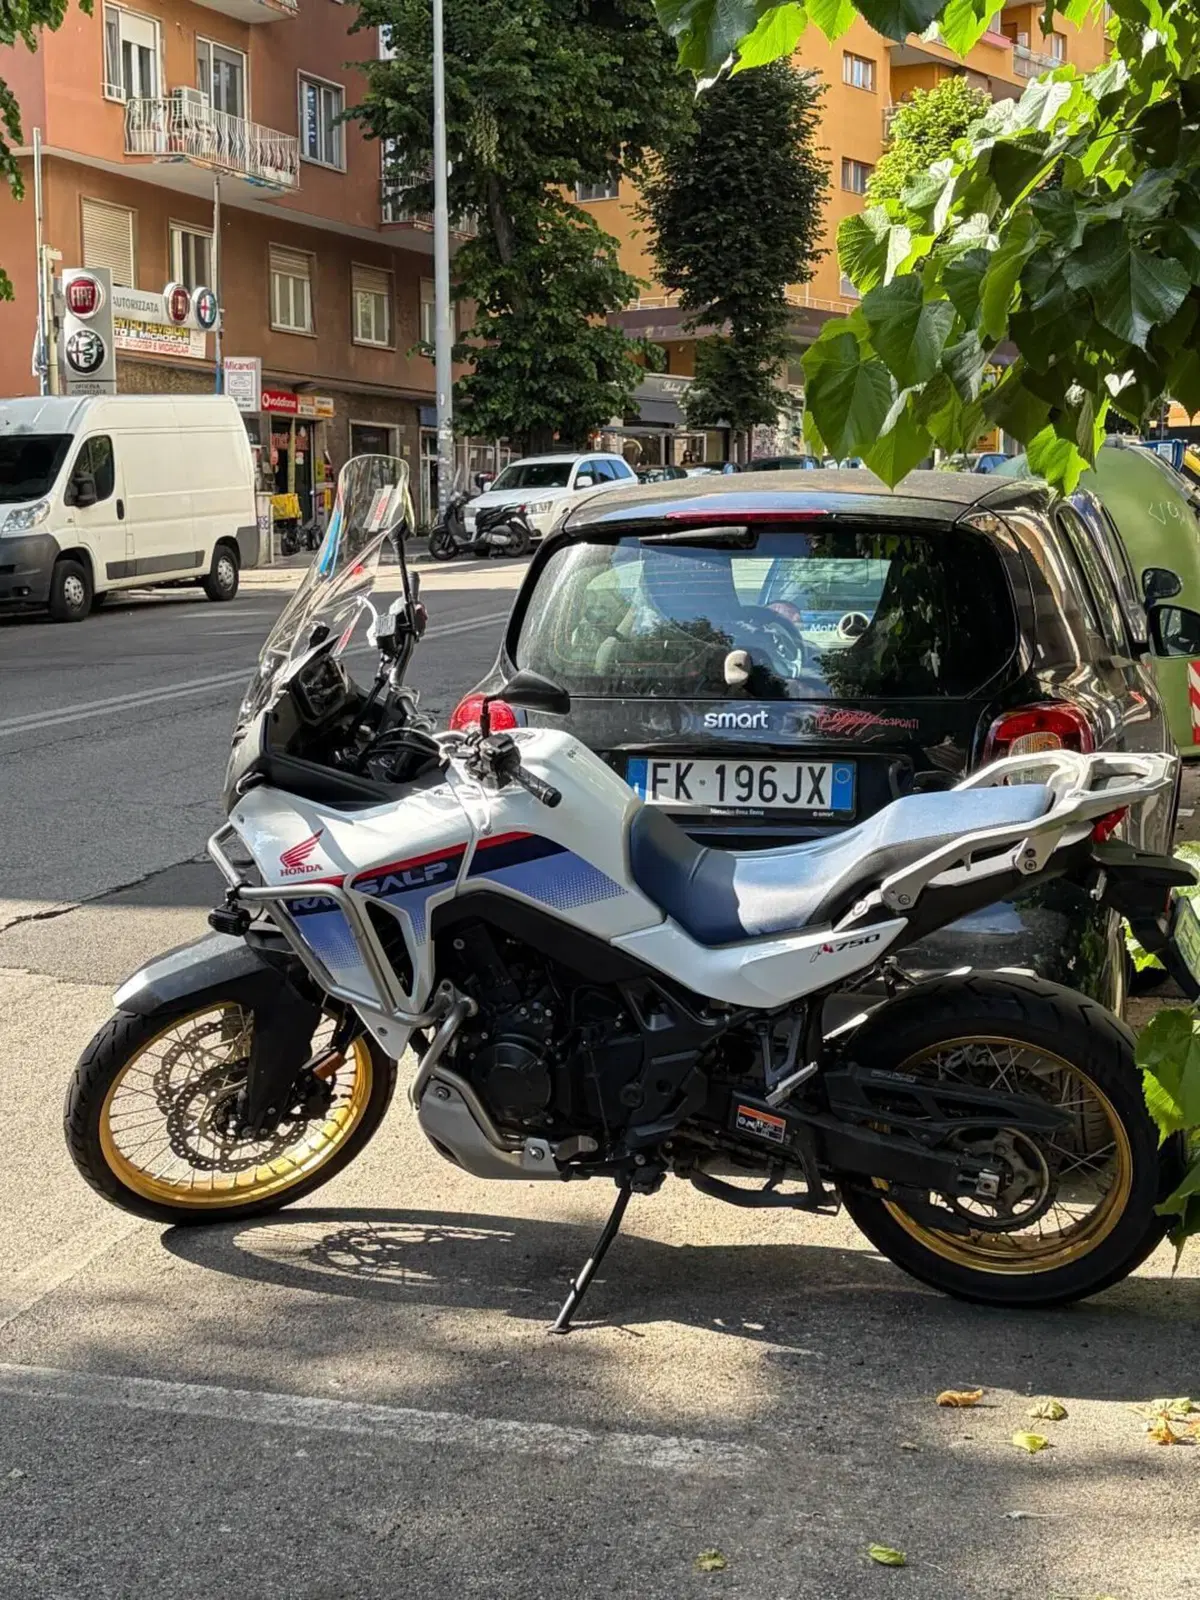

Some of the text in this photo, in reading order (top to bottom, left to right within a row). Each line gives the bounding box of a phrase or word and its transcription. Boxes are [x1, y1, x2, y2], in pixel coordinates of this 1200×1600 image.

[704, 710, 769, 729] smart
[651, 762, 828, 805] FK 196JX
[280, 864, 324, 877] HONDA
